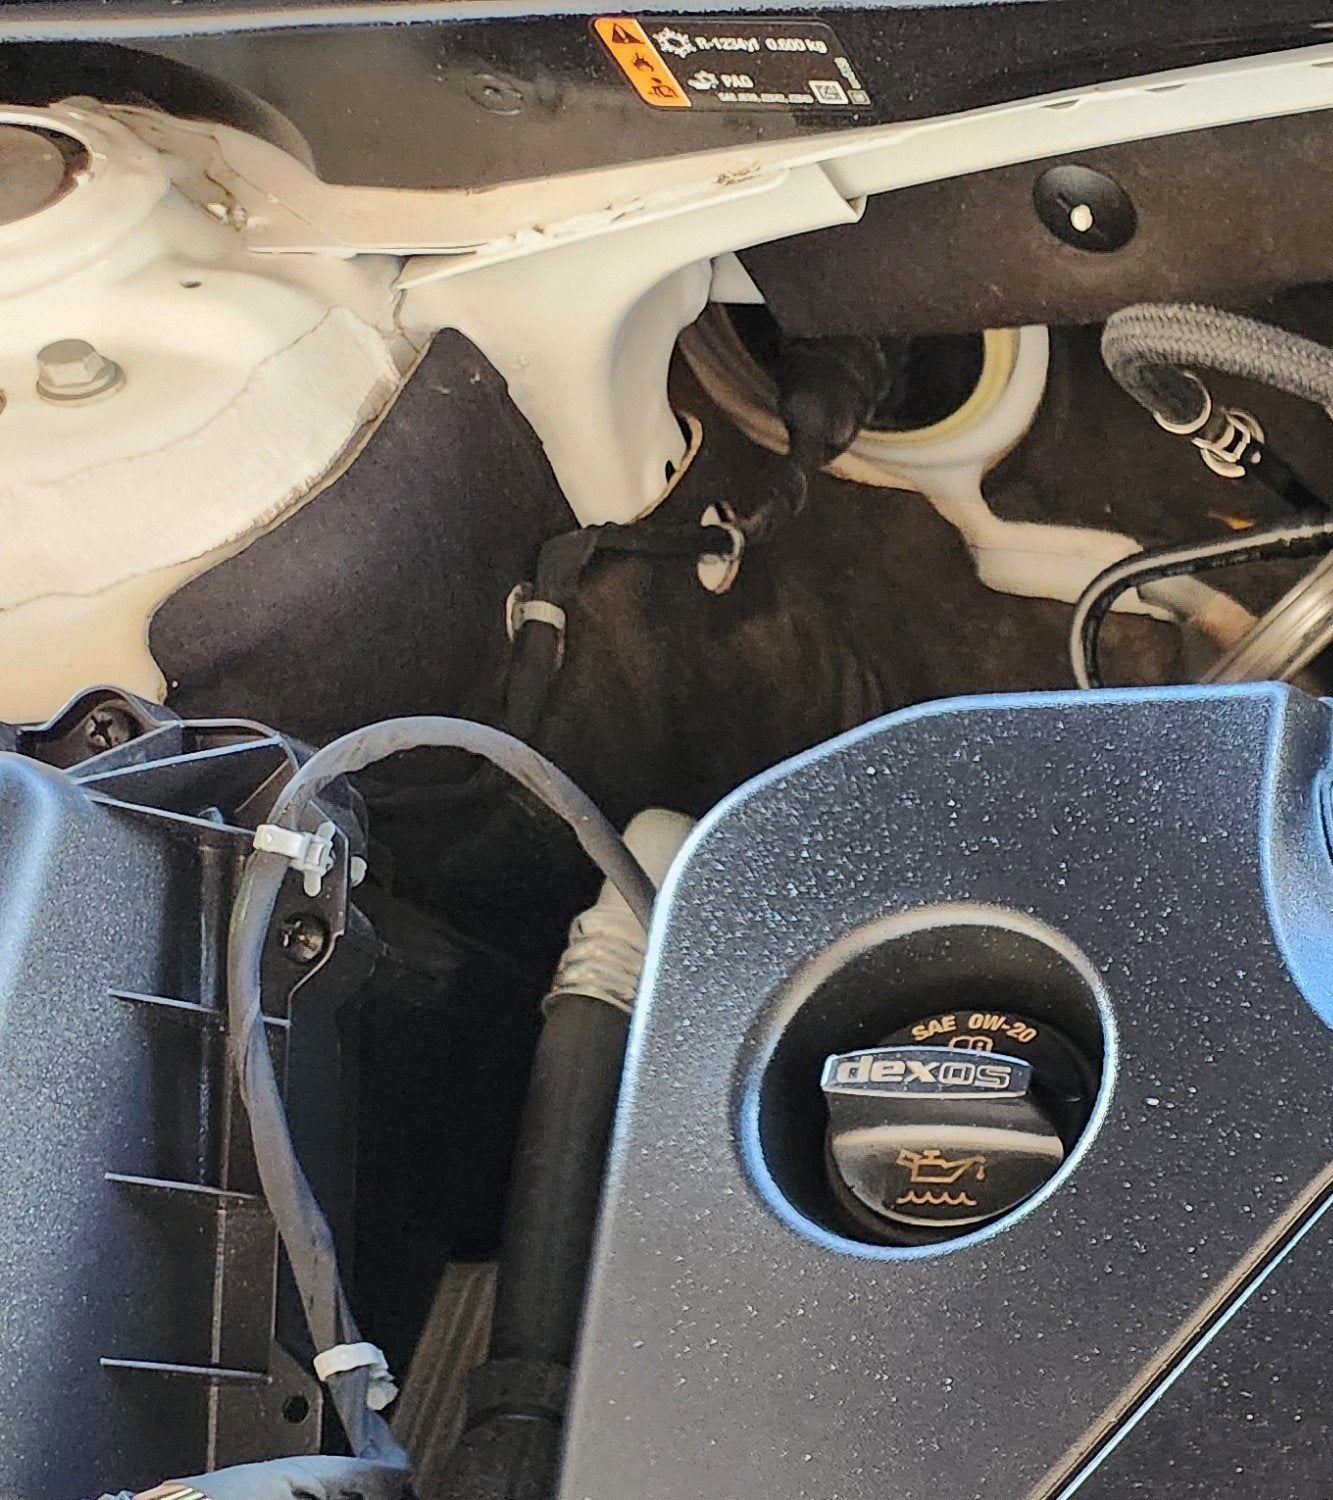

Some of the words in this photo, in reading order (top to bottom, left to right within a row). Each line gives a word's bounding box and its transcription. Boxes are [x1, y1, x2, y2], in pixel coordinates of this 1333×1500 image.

[911, 1015, 957, 1042] SAE
[968, 1014, 1039, 1044] 0W-20
[836, 1054, 1012, 1089] dexos
